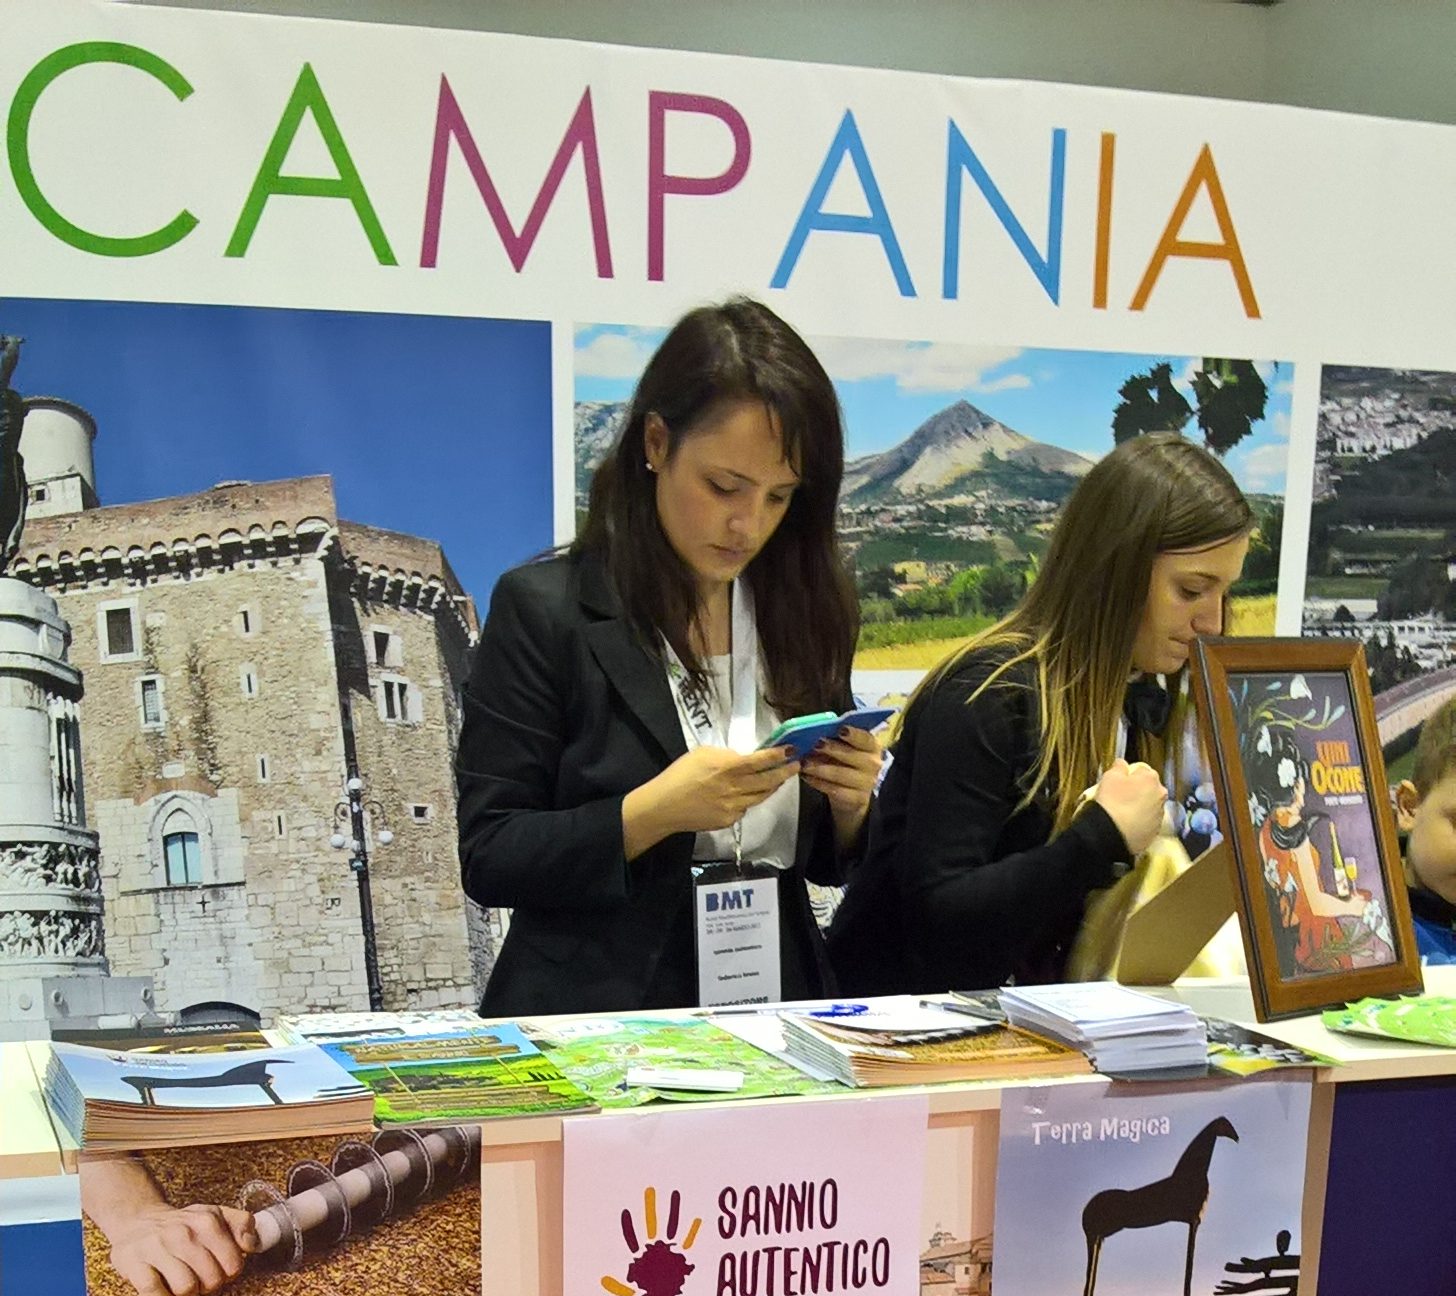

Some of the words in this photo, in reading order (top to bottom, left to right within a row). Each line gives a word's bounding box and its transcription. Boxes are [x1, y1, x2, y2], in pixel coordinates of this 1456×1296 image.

[6, 41, 1262, 320] CAMPANIA
[705, 888, 754, 912] BMT
[1032, 1121, 1092, 1145] Terra
[1100, 1116, 1170, 1142] Magica
[717, 1178, 838, 1240] SANNIO
